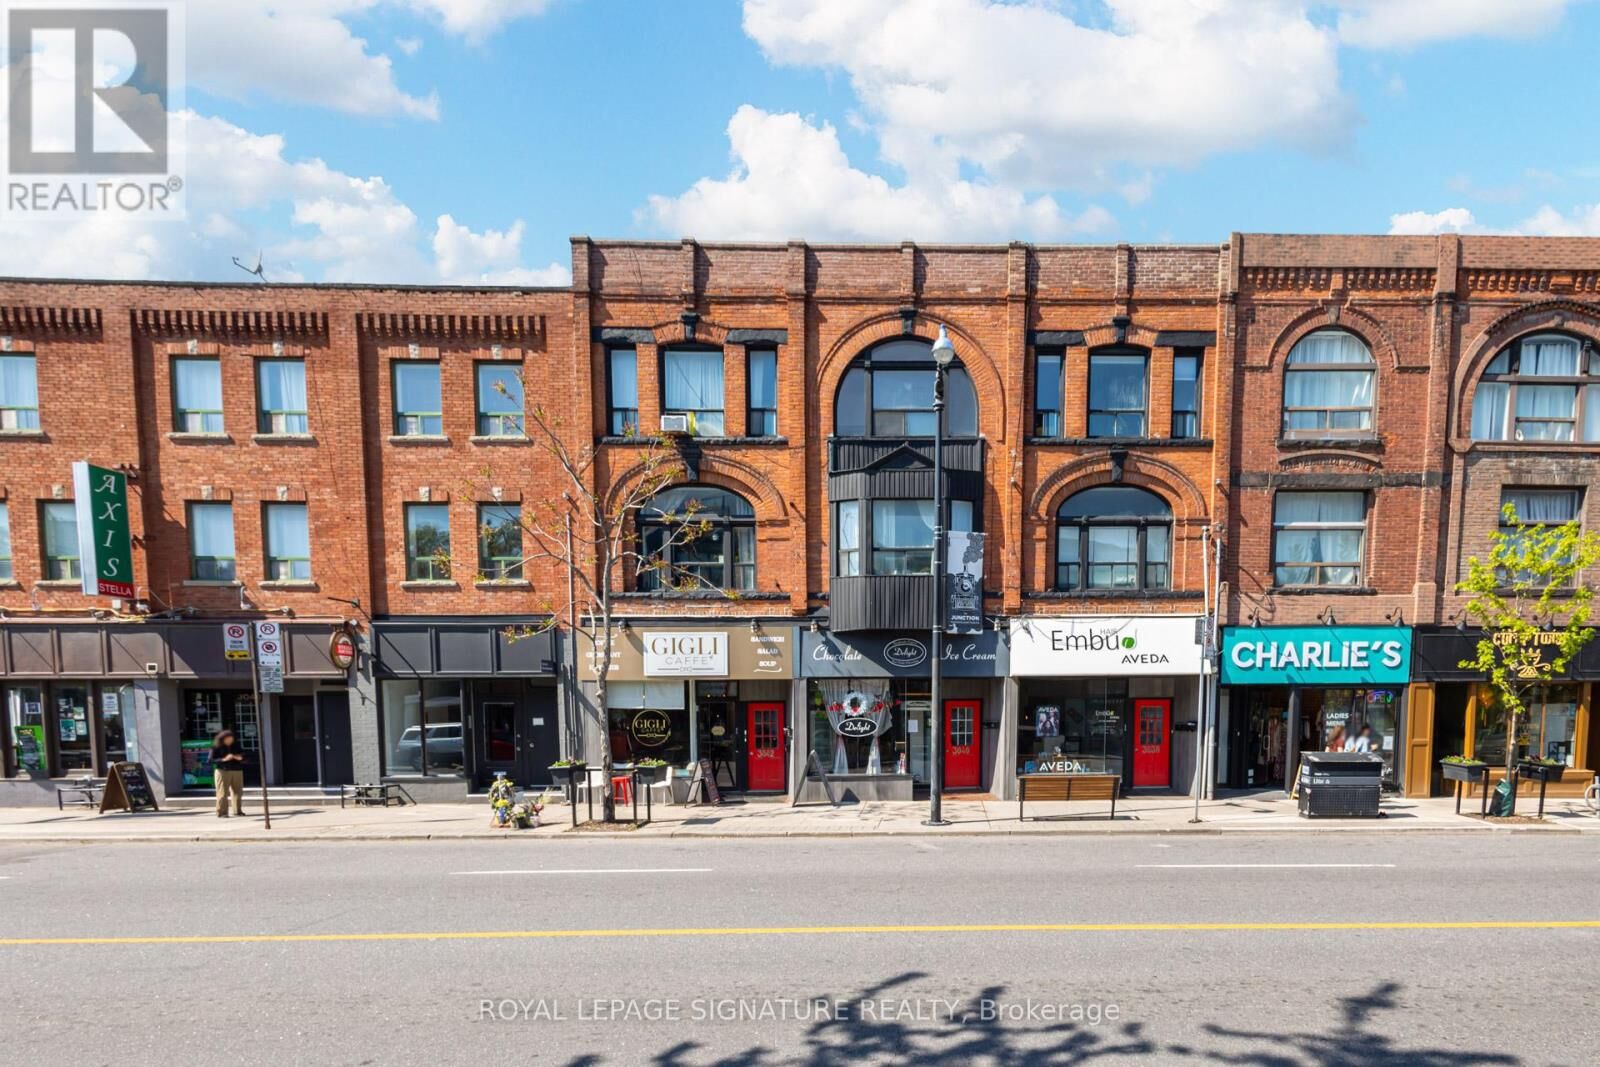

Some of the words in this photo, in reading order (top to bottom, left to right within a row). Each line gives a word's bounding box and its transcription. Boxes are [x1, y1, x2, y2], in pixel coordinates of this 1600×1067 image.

[94, 474, 121, 577] AXIS
[99, 583, 132, 597] STELLA
[651, 636, 717, 656] GIGLI
[813, 643, 862, 661] Chocolate
[892, 647, 918, 658] Delight
[942, 643, 959, 660] Ice
[962, 643, 997, 661] Cream
[1121, 654, 1170, 664] AVEDA
[634, 719, 666, 729] GIGLI
[844, 721, 871, 732] Delight
[1039, 760, 1083, 772] AVEDA
